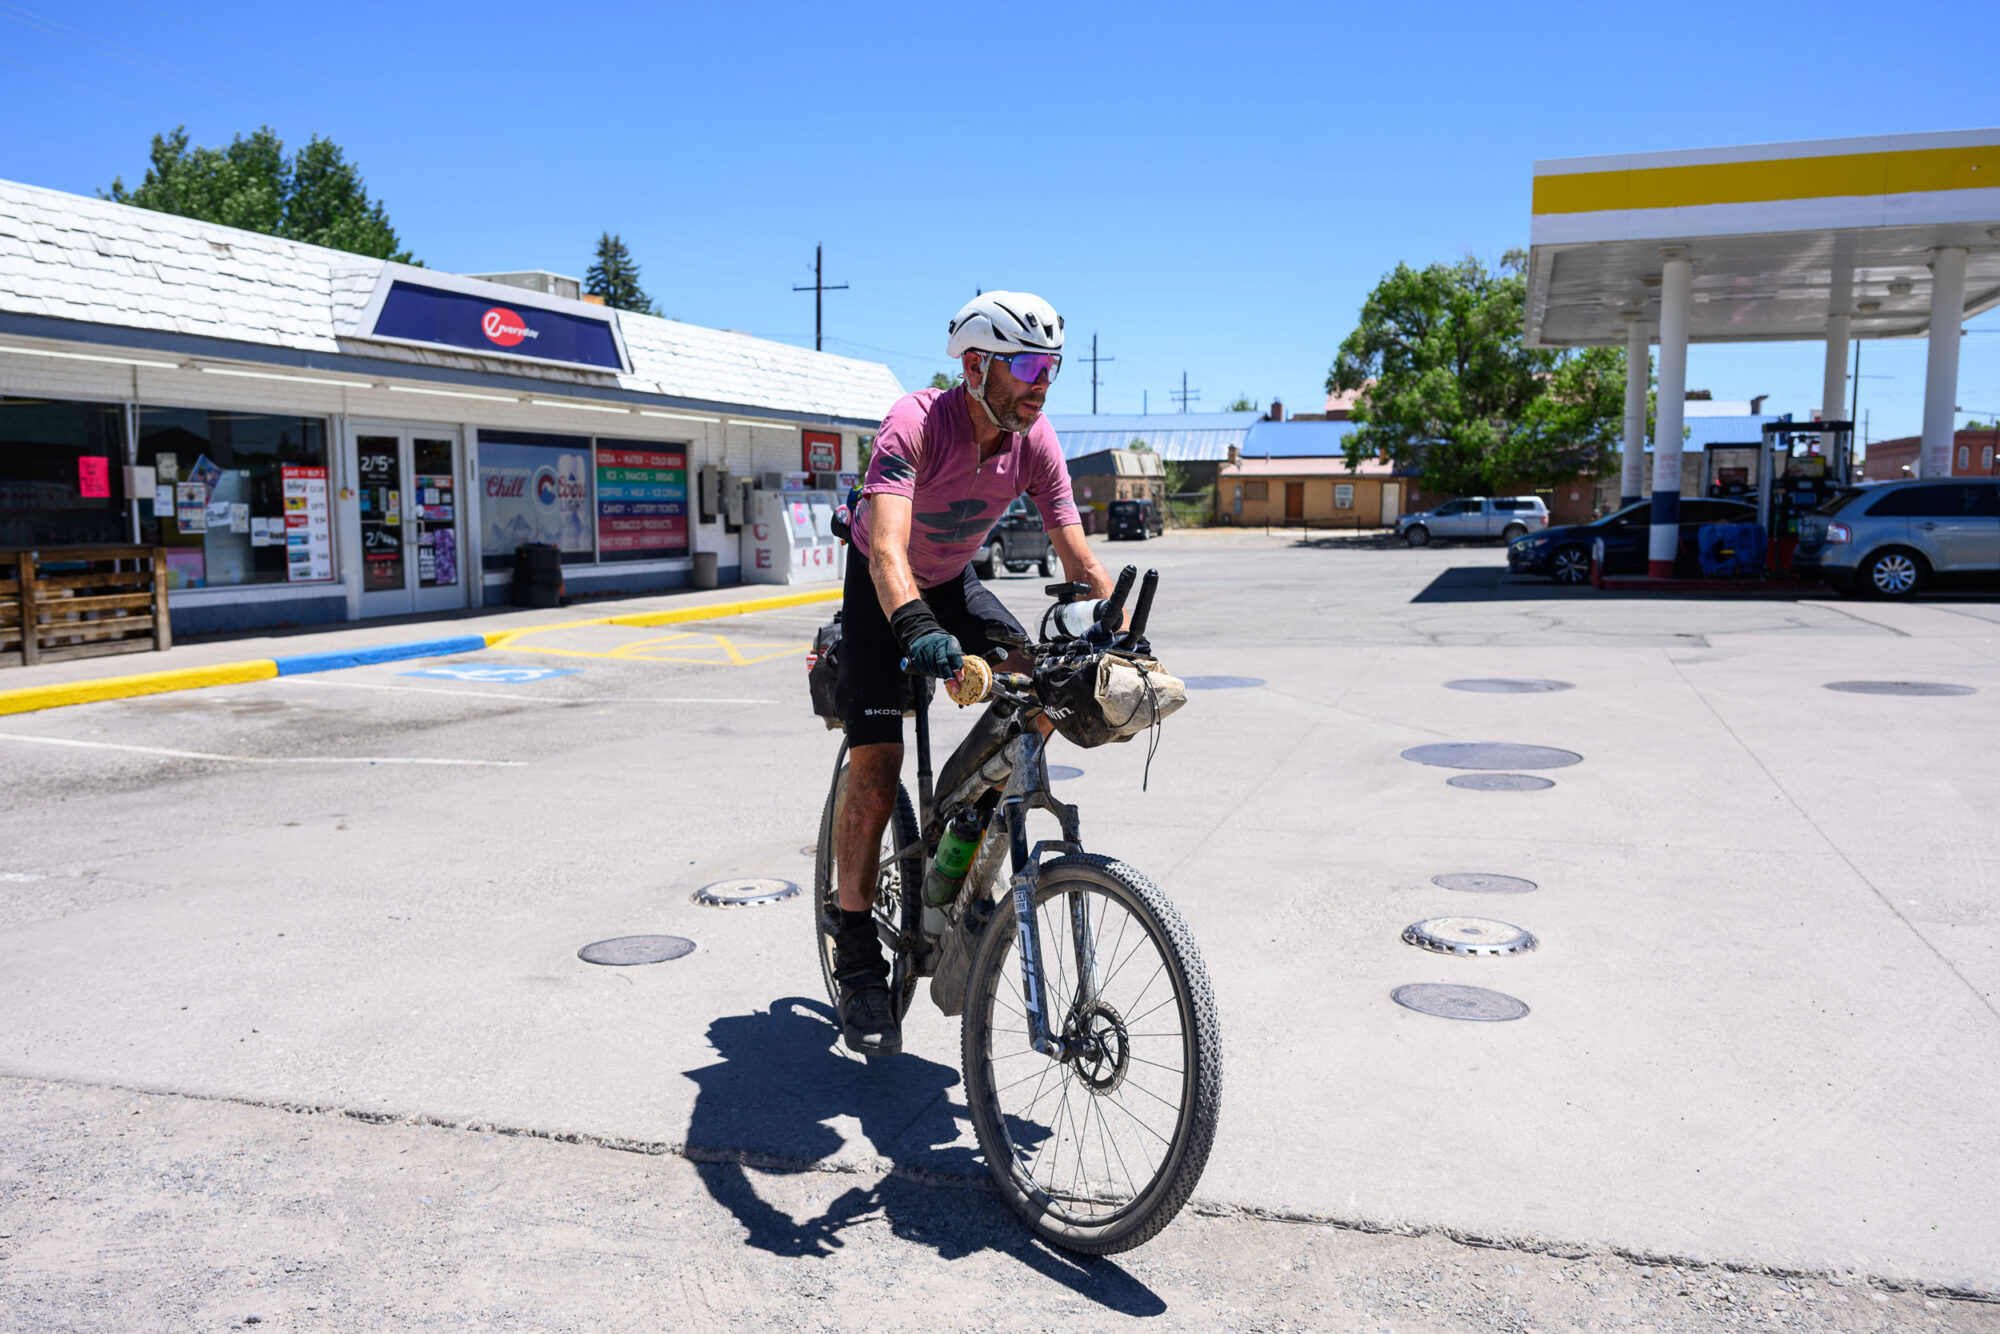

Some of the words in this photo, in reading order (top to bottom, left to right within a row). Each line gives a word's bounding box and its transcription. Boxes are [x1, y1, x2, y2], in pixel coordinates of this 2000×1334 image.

[484, 312, 539, 339] everyday
[597, 454, 616, 464] SODA
[623, 455, 644, 465] WATER
[606, 470, 617, 481] ICE
[624, 471, 649, 481] SNACKS
[655, 472, 675, 482] BREAD
[485, 475, 527, 498] Chill
[599, 487, 623, 497] COFFEE
[602, 503, 625, 514] CANDY
[612, 520, 641, 531] TOBACCO
[752, 496, 773, 569] ICE
[802, 546, 834, 568] ICE
